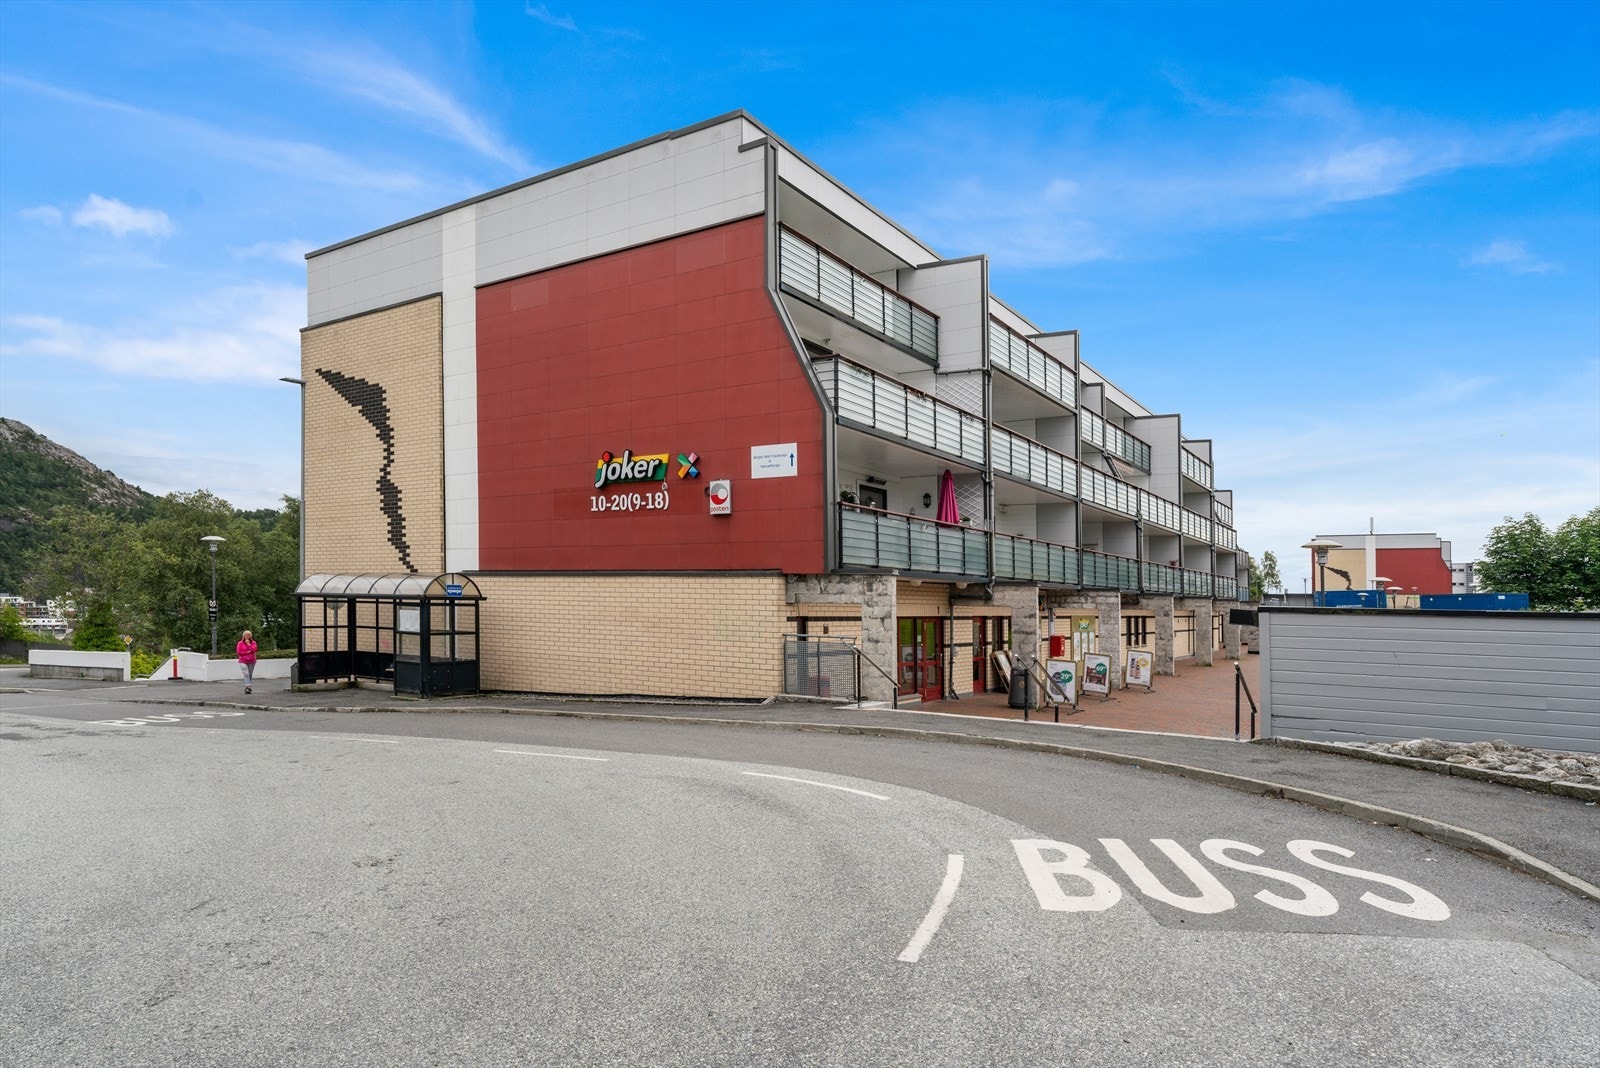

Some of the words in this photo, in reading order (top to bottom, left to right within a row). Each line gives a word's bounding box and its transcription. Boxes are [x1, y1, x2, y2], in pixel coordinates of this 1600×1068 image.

[594, 449, 660, 488] joker
[590, 491, 669, 511] 10-20(9-18)
[1011, 838, 1452, 921] BUSS
